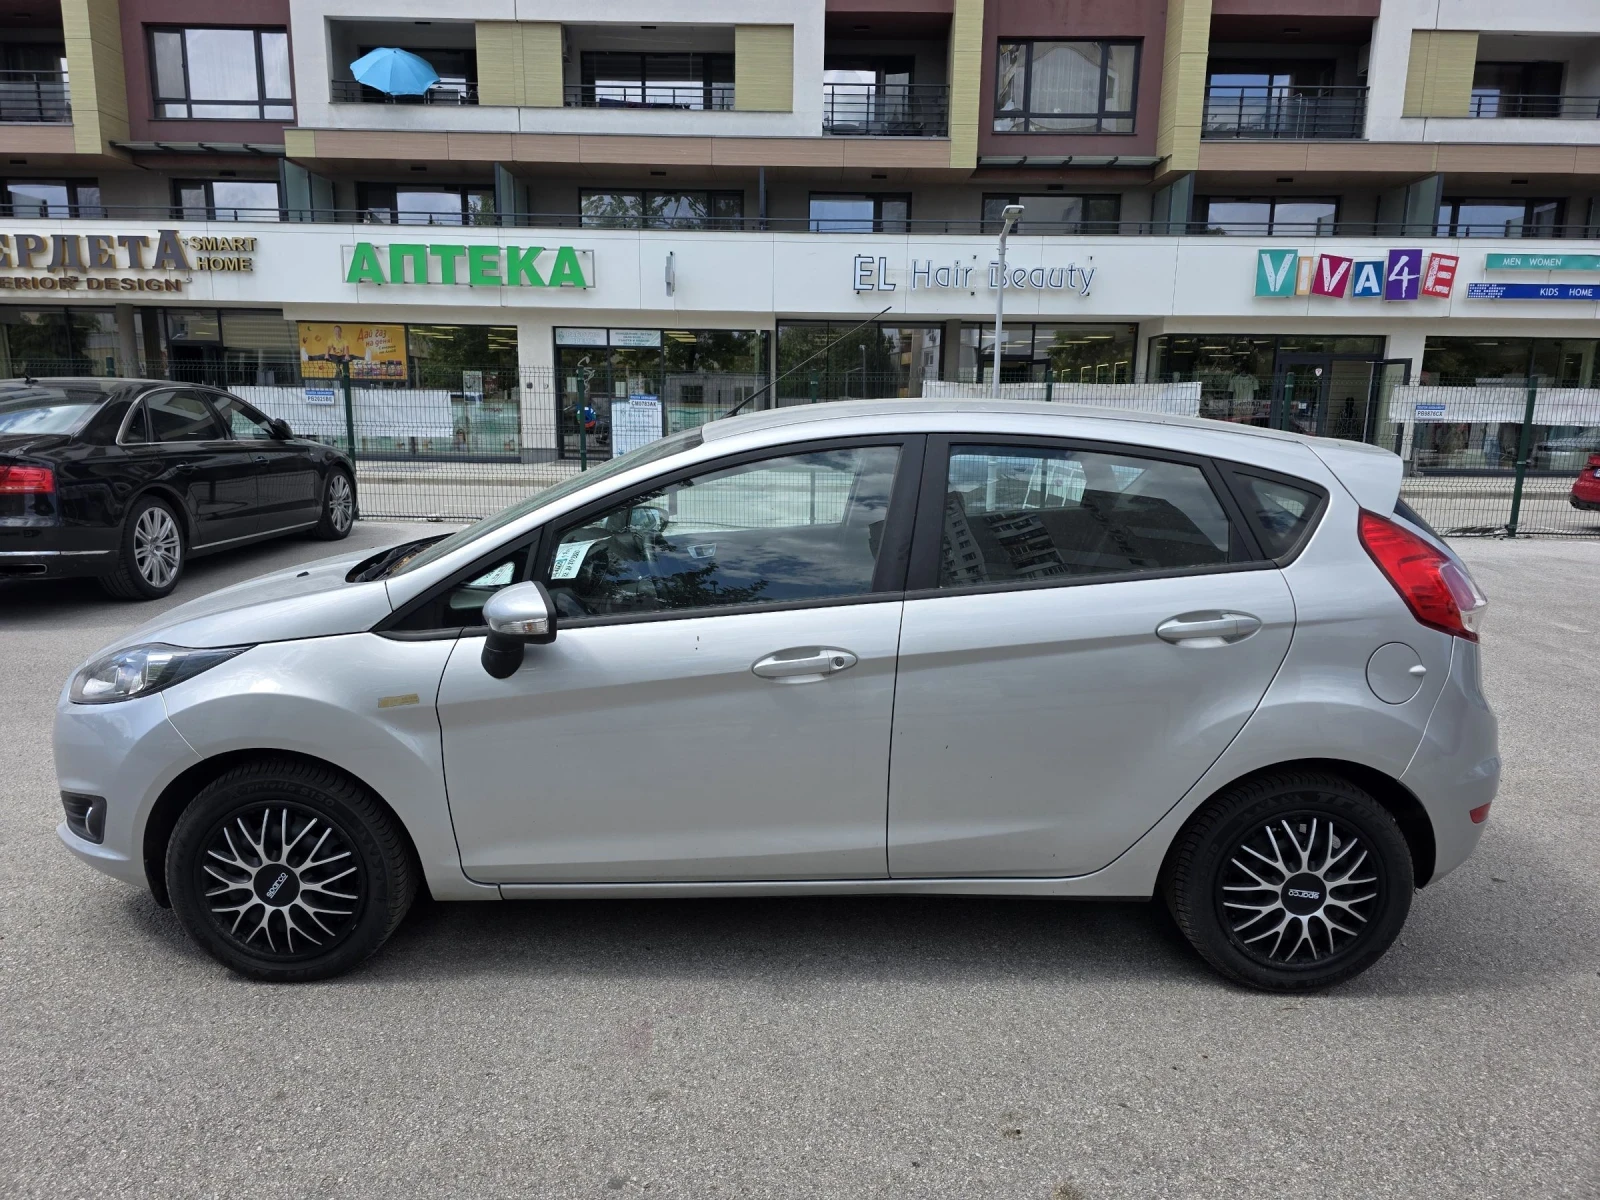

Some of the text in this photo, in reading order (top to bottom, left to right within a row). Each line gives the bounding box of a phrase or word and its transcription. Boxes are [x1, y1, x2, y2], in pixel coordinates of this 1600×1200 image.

[189, 236, 257, 252] SMART
[197, 256, 253, 271] HOME
[346, 242, 588, 288] АПТЕКА
[1502, 257, 1562, 267] MEN WOMEN
[853, 255, 1097, 297] EL Hair Beauty
[86, 277, 183, 293] DESIGN
[1539, 287, 1593, 297] KIDS HOME
